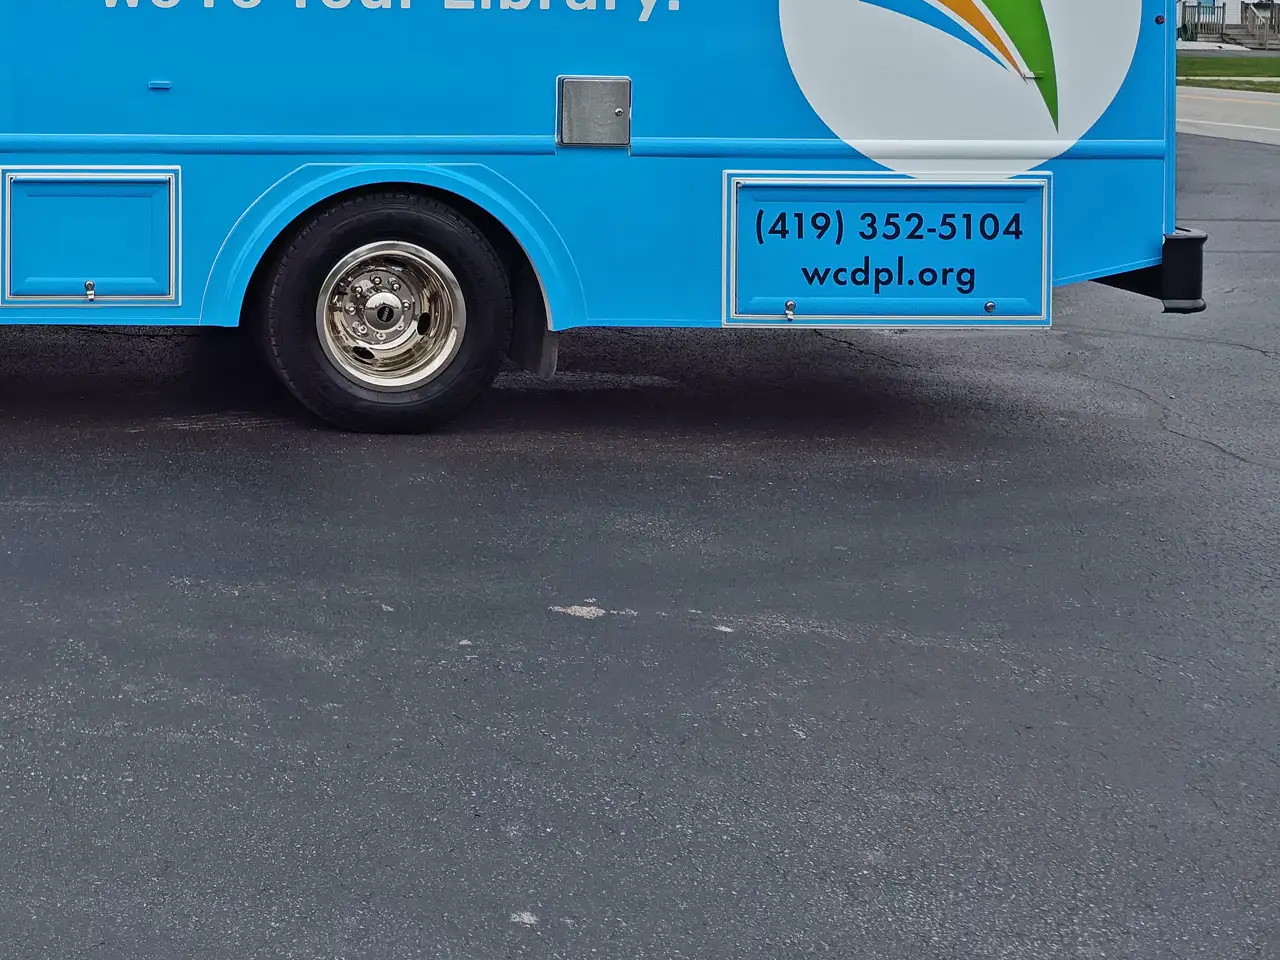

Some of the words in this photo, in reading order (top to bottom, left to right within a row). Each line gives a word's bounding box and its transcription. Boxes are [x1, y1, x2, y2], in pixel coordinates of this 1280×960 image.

[755, 208, 845, 246] (419)
[858, 211, 1024, 241] 352-5104
[801, 255, 976, 295] wcdpl.org
